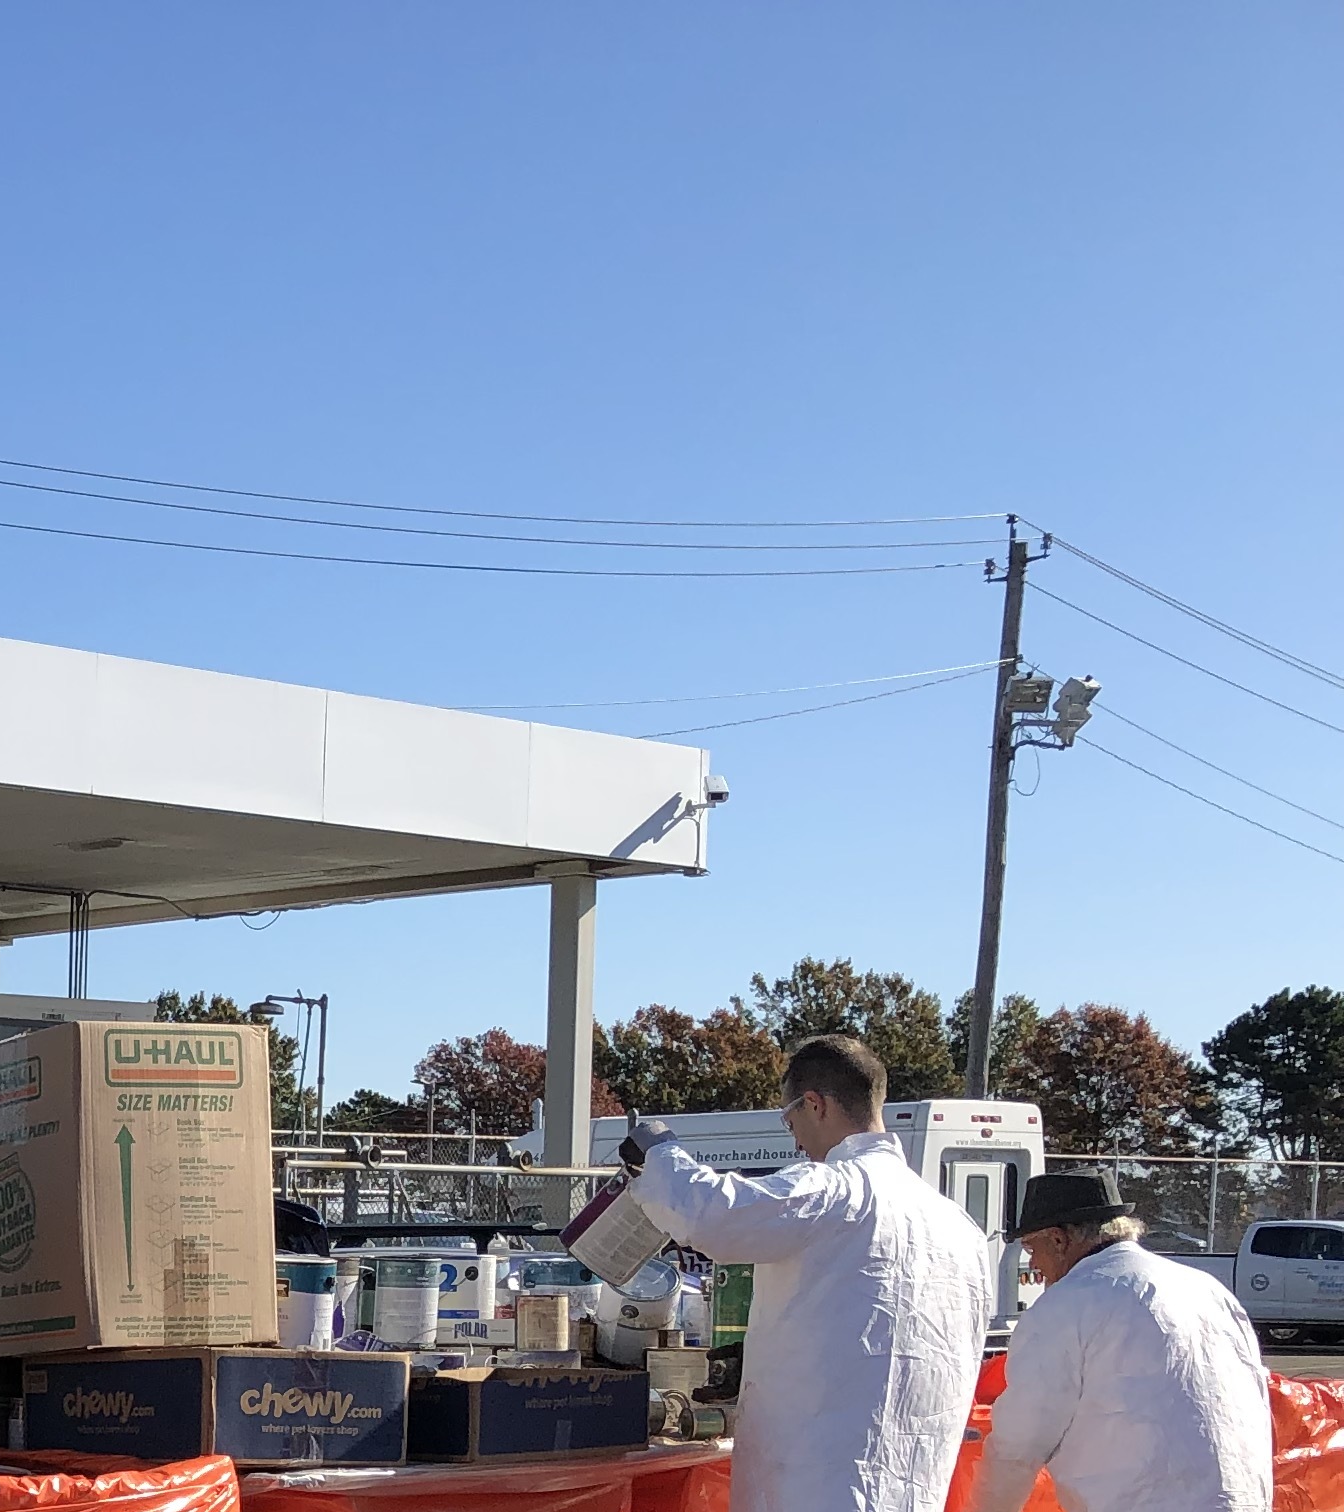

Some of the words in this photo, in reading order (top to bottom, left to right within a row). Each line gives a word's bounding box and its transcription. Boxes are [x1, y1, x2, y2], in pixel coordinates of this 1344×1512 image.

[116, 1094, 153, 1112] SIZE
[157, 1094, 234, 1112] MATTERS!
[439, 1263, 458, 1292] 2
[454, 1322, 488, 1339] POLAR
[63, 1388, 155, 1423] chewy.com
[240, 1383, 382, 1424] chewy.com
[262, 1423, 290, 1434] where
[291, 1424, 305, 1435] pet
[337, 1426, 360, 1437] shop
